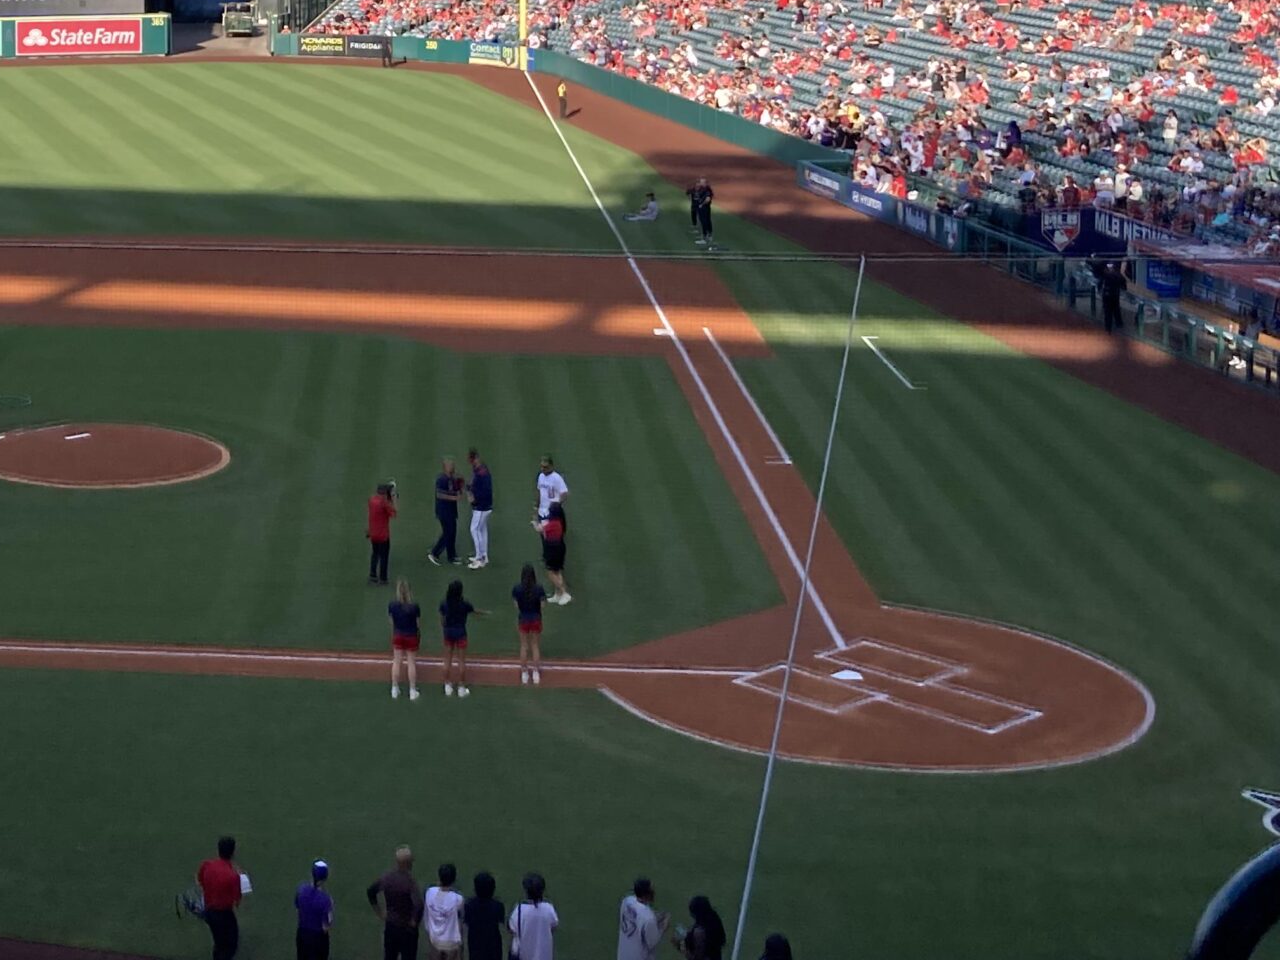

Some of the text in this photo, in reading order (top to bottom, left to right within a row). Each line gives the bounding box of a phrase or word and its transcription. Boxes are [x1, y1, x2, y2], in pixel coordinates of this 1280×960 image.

[151, 17, 164, 27] 365
[300, 44, 343, 52] Appliances
[470, 43, 500, 54] Contact
[1094, 211, 1120, 238] MLB
